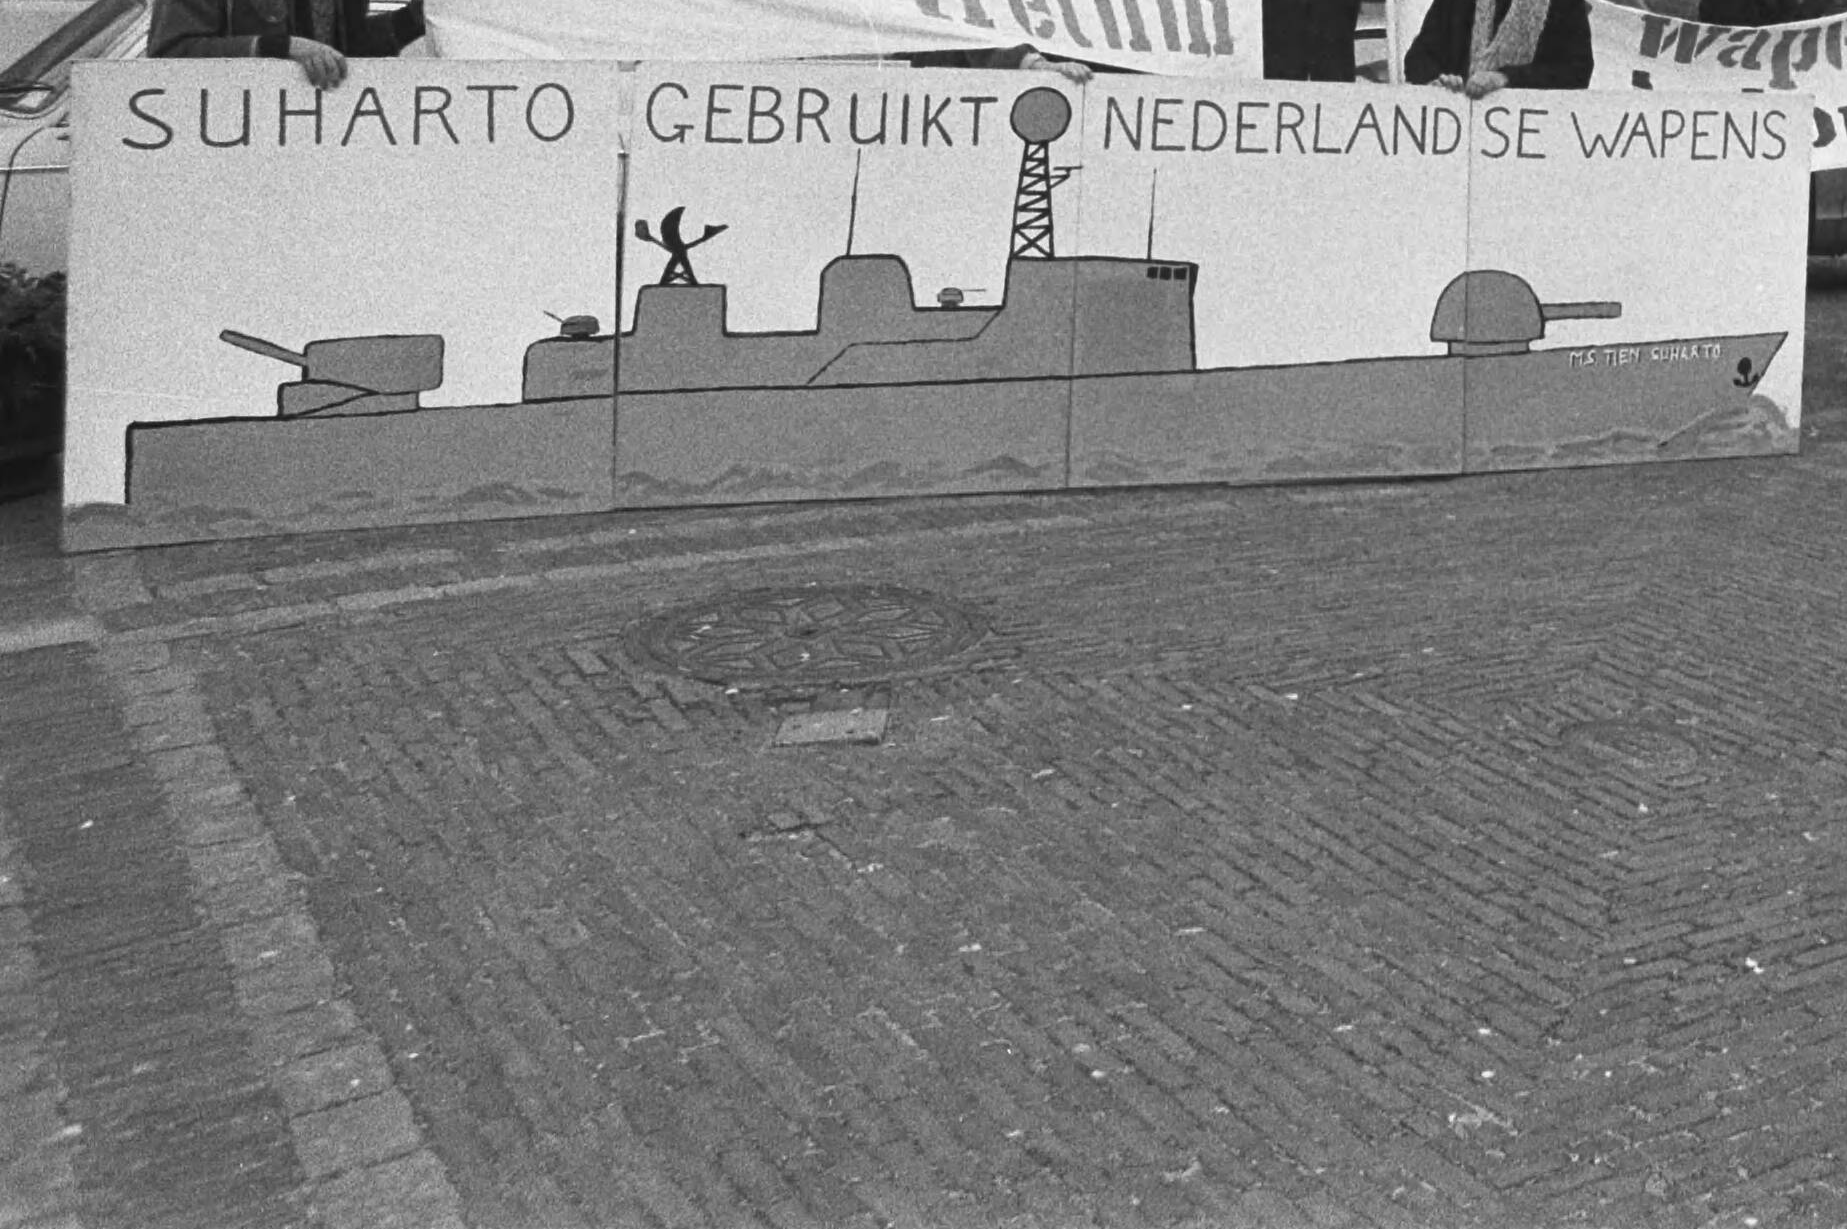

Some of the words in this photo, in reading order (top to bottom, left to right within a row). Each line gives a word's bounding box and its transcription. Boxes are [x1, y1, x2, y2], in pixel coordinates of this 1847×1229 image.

[121, 81, 575, 150] SUHARTO
[645, 81, 998, 147] GEBRUIKT
[1570, 108, 1787, 161] WAPENS
